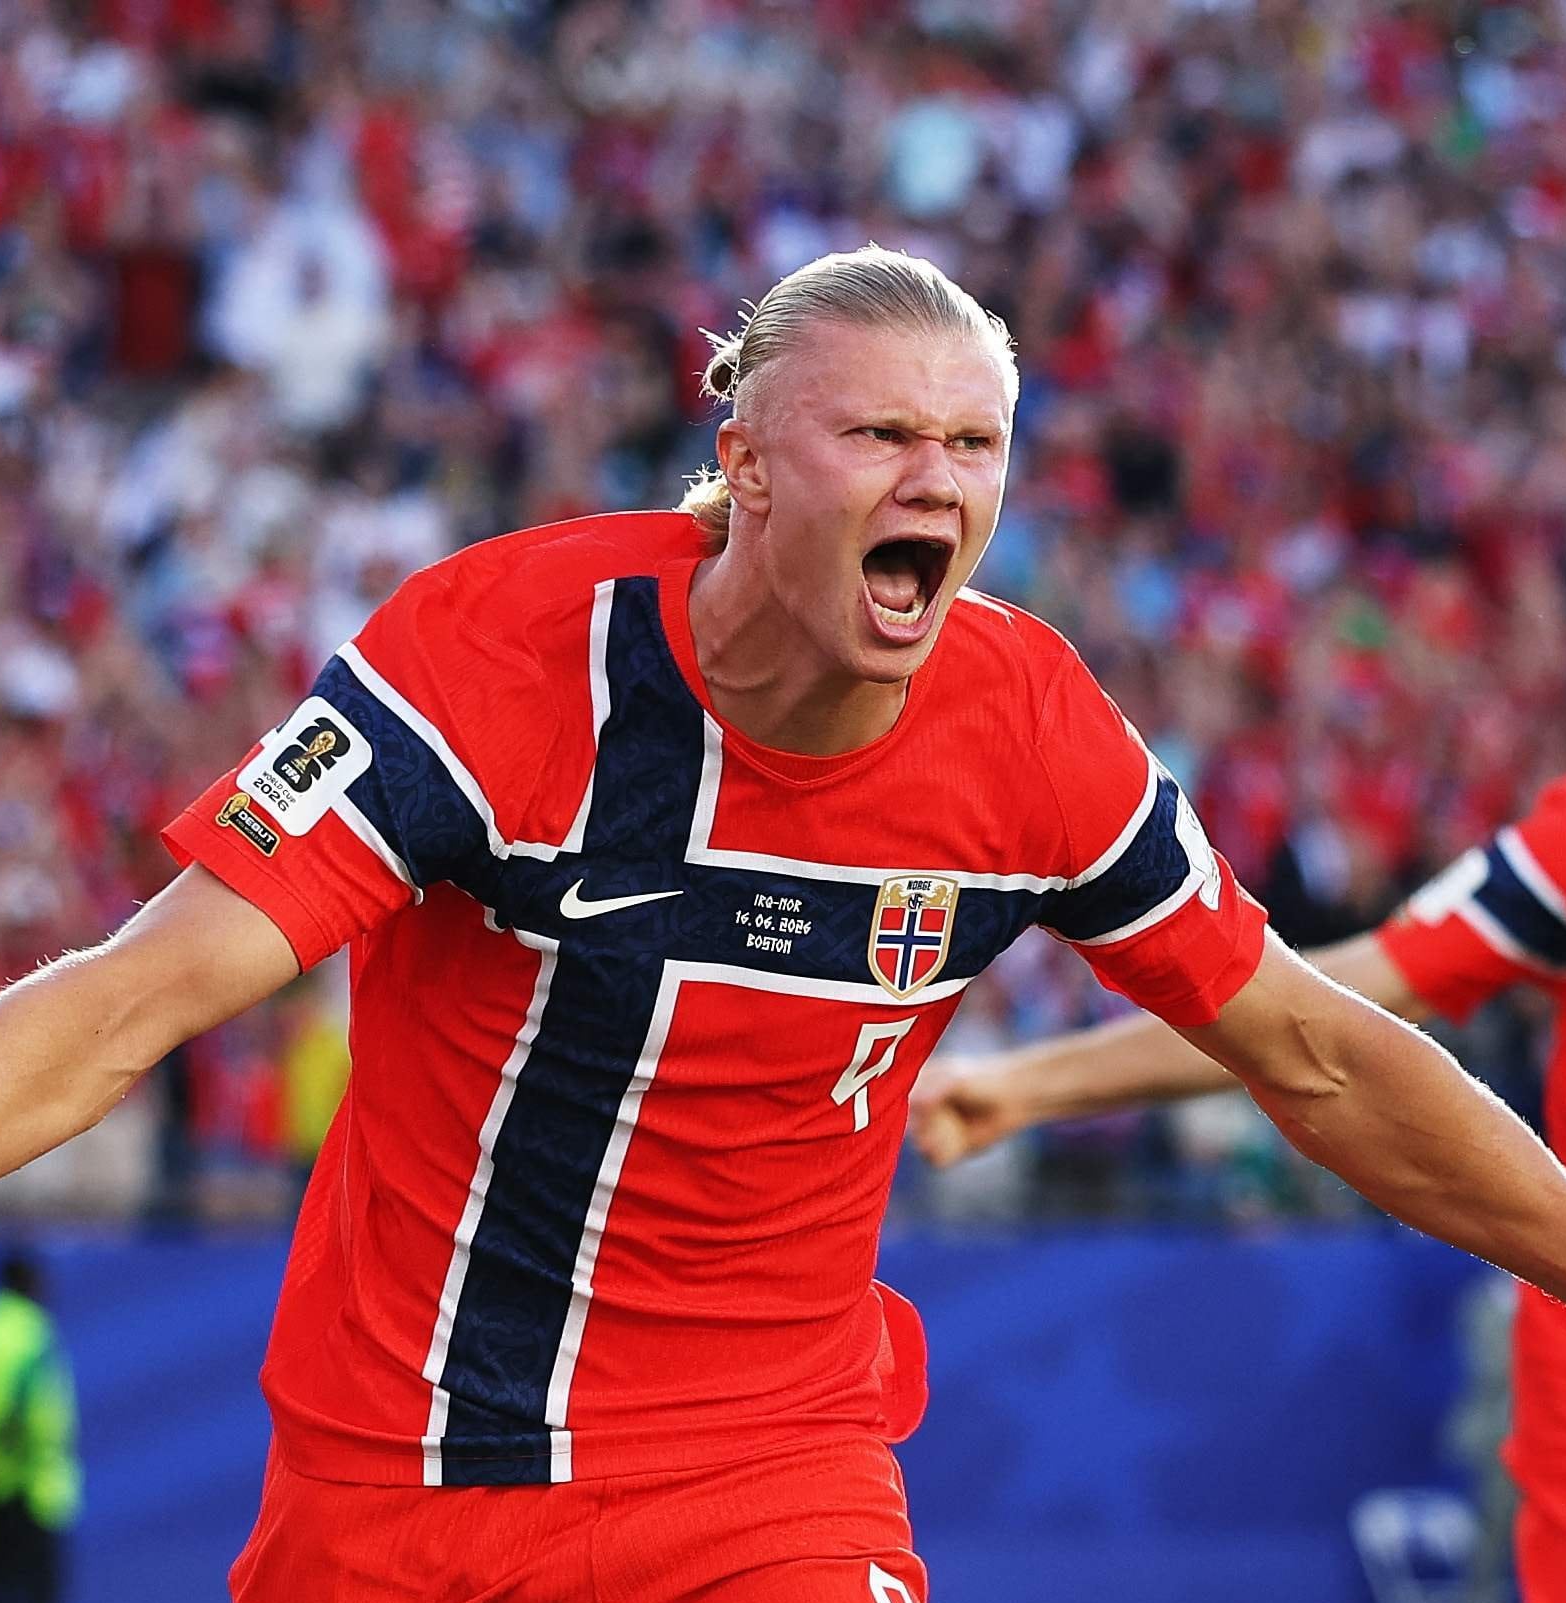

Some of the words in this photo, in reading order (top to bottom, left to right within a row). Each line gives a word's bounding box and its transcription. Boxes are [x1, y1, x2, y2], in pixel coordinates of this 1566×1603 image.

[263, 771, 283, 790] WORLD
[281, 762, 301, 784] FIFA
[252, 777, 290, 812] 2026
[237, 810, 275, 843] DEBUT
[906, 880, 933, 891] NORGE
[753, 893, 803, 913] IRQ-NOR
[746, 932, 792, 955] BOSTON
[830, 1014, 918, 1133] 9
